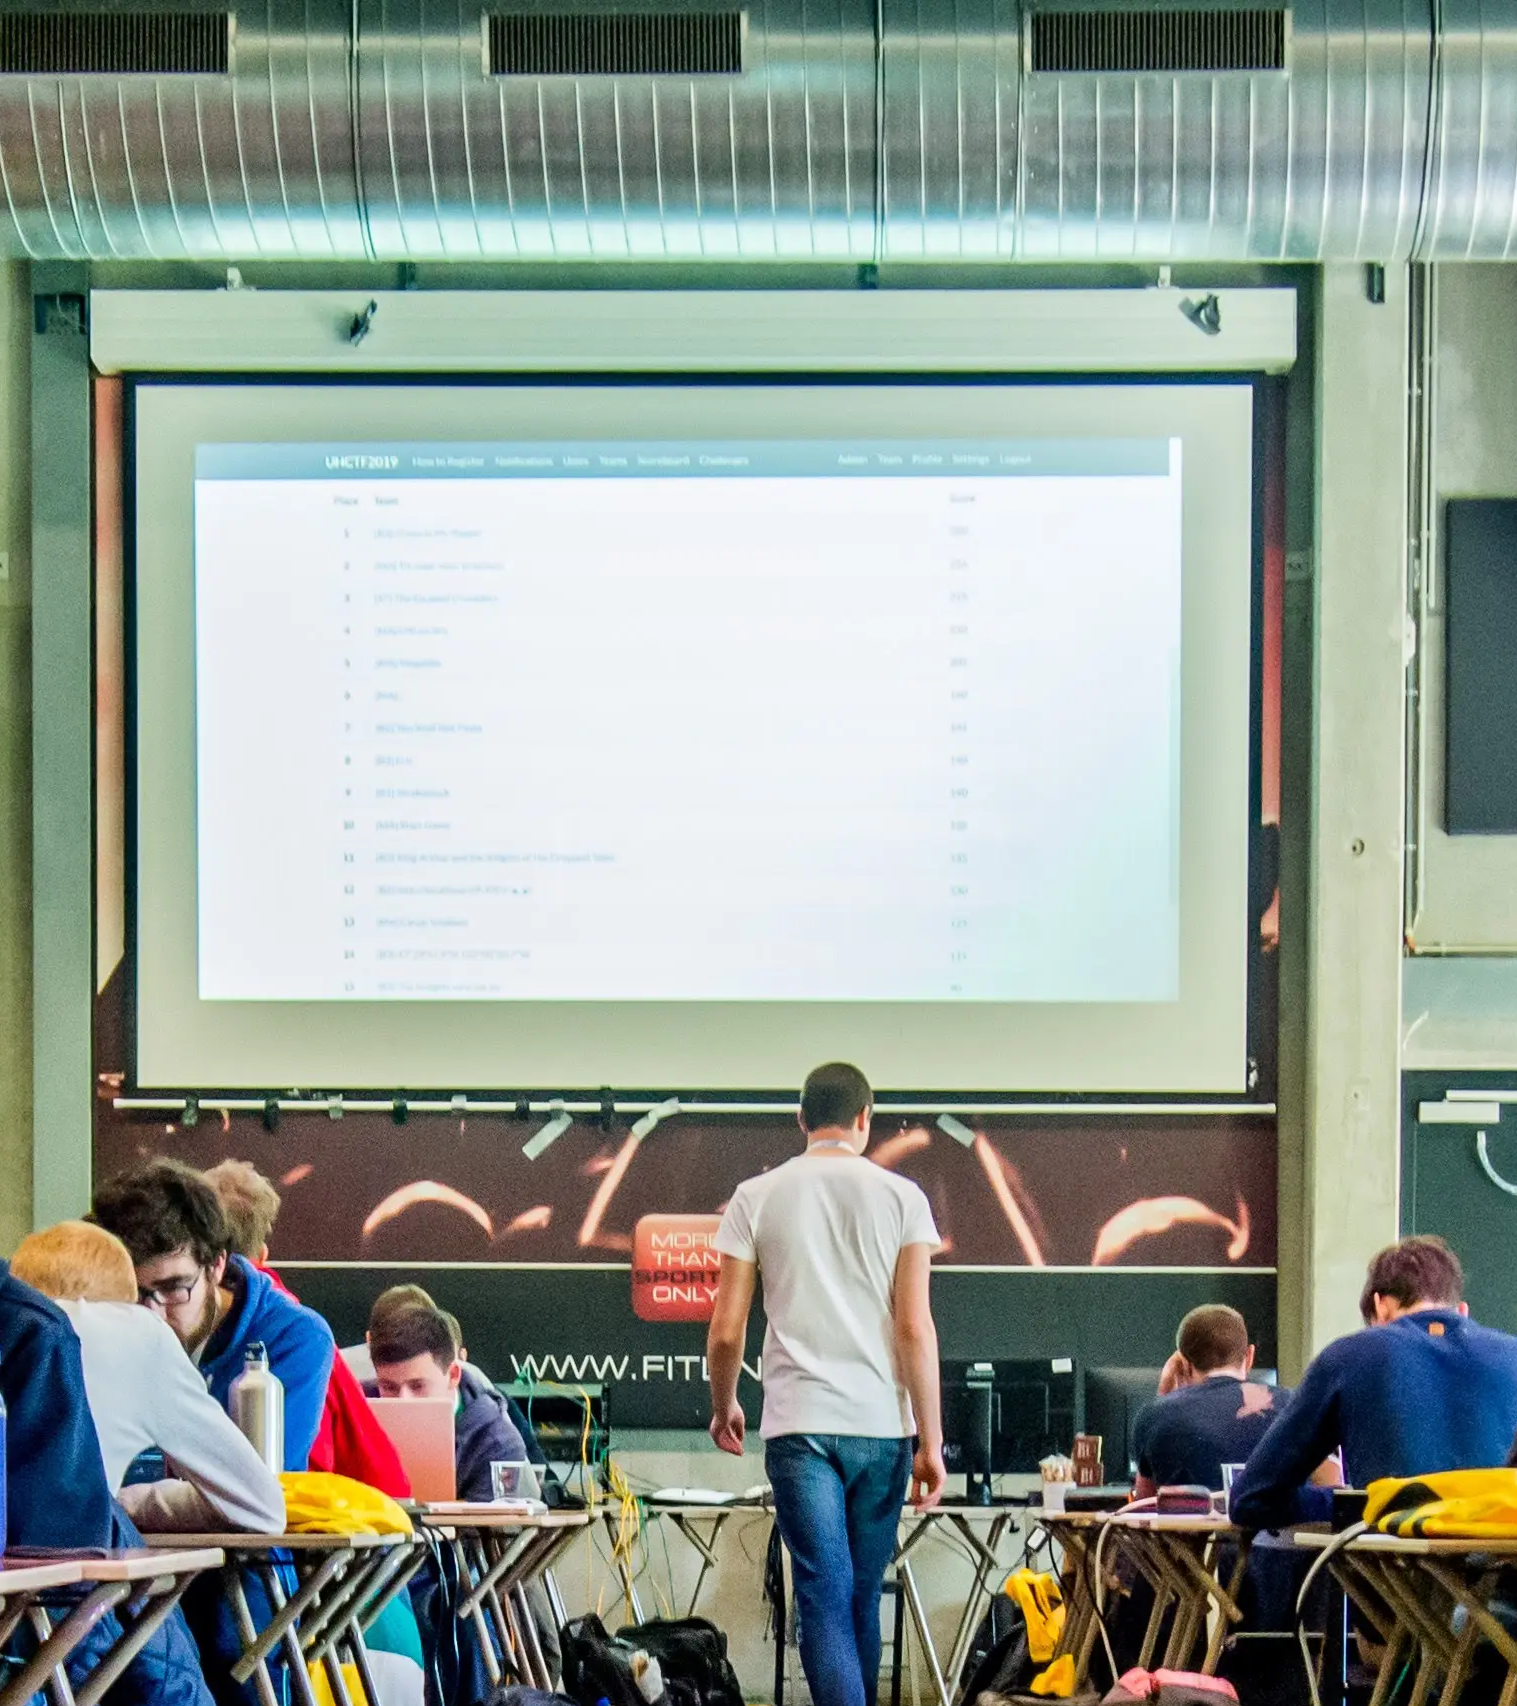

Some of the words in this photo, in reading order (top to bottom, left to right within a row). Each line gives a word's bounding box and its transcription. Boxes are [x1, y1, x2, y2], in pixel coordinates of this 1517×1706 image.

[325, 454, 399, 470] UHCTF2019
[911, 453, 943, 466] Profile
[951, 453, 990, 468] Settings
[999, 453, 1032, 467] Logout
[652, 1250, 721, 1268] THAN
[652, 1285, 720, 1303] ONLY
